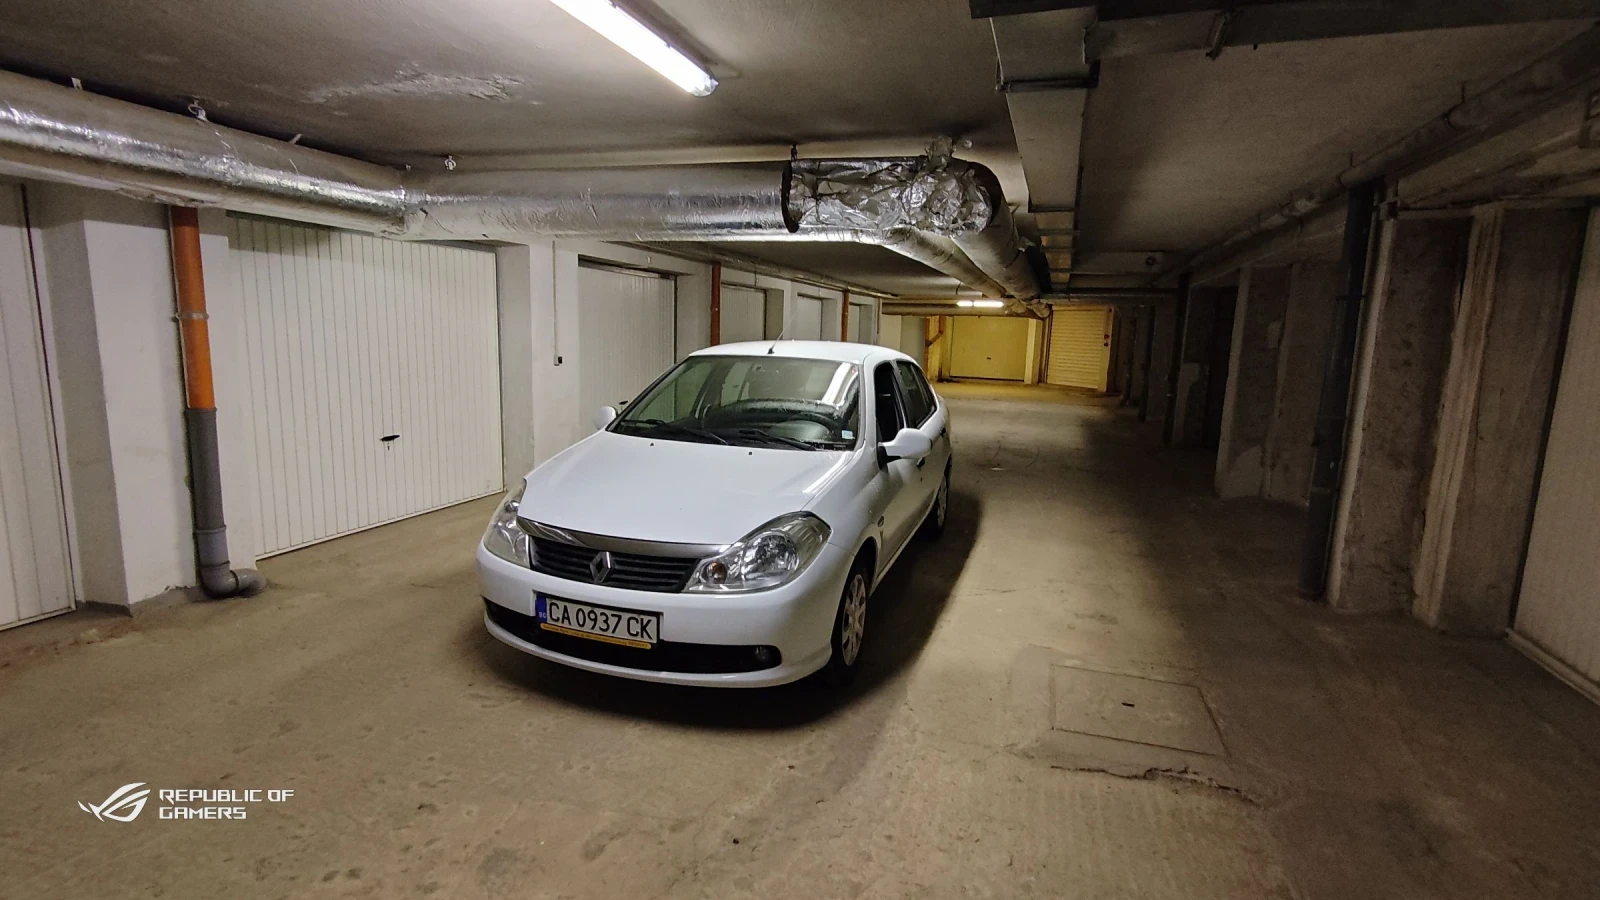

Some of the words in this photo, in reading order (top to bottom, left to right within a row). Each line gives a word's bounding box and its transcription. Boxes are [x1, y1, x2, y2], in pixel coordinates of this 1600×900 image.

[549, 602, 572, 626] CA
[575, 607, 622, 634] 0937
[626, 616, 653, 640] CK
